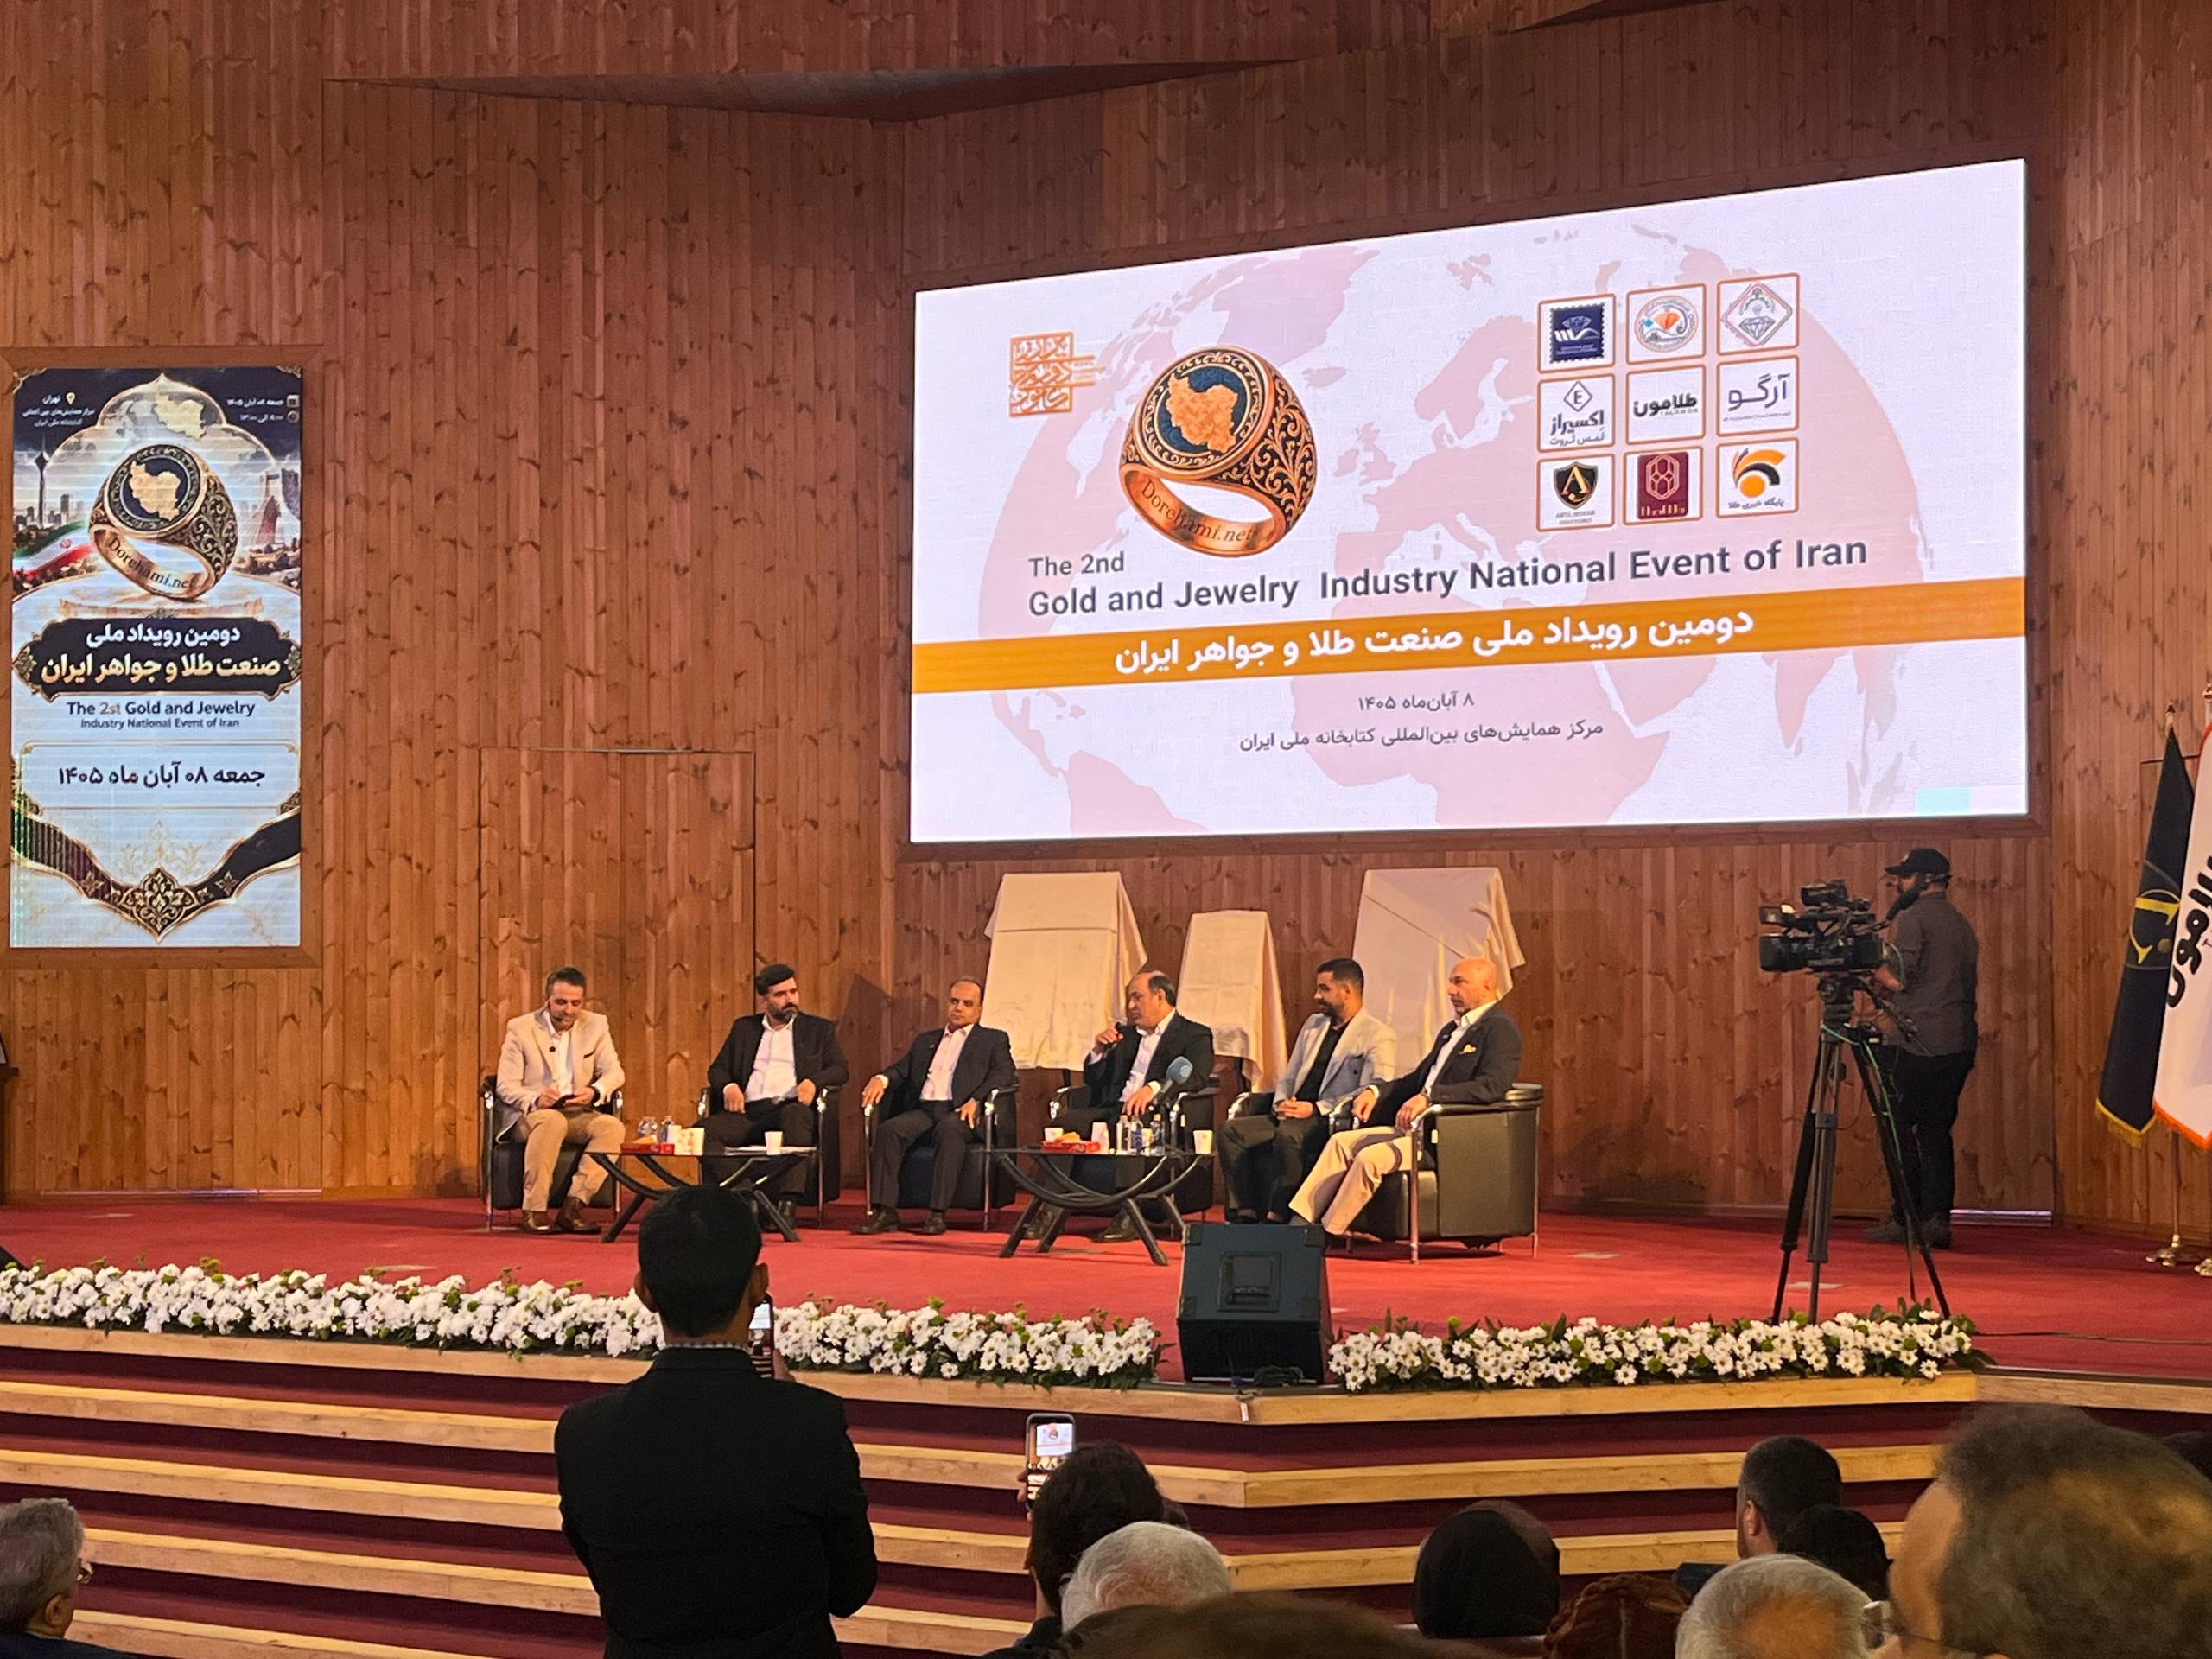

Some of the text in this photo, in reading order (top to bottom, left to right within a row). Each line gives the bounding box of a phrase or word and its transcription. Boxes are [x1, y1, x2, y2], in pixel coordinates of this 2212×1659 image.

[1633, 393, 1697, 417] طلامون
[1028, 550, 1125, 577] The 2nd
[1028, 539, 1866, 616] Gold and Jewelry Industry National Event of Iran
[86, 623, 240, 648] دومین رویداد ملی
[1116, 611, 1753, 674] دومین رویداد ملی صنعت طلا و جواهر ایران
[41, 653, 281, 683] صنعت طلا و جواهر ایران
[67, 701, 256, 717] The 2st Gold and Jewelry
[1358, 696, 1396, 710] ۱۴۰۵
[1462, 694, 1475, 707] ۸
[80, 718, 240, 729] Industry National Event of Iran
[1567, 719, 1604, 740] مرکز
[1239, 733, 1274, 752] ایران
[1280, 733, 1310, 750] ملی
[1316, 728, 1375, 744] کتابخانه
[59, 760, 266, 788] جمعه ۰۸ آبان ماه ۱۴۰۵
